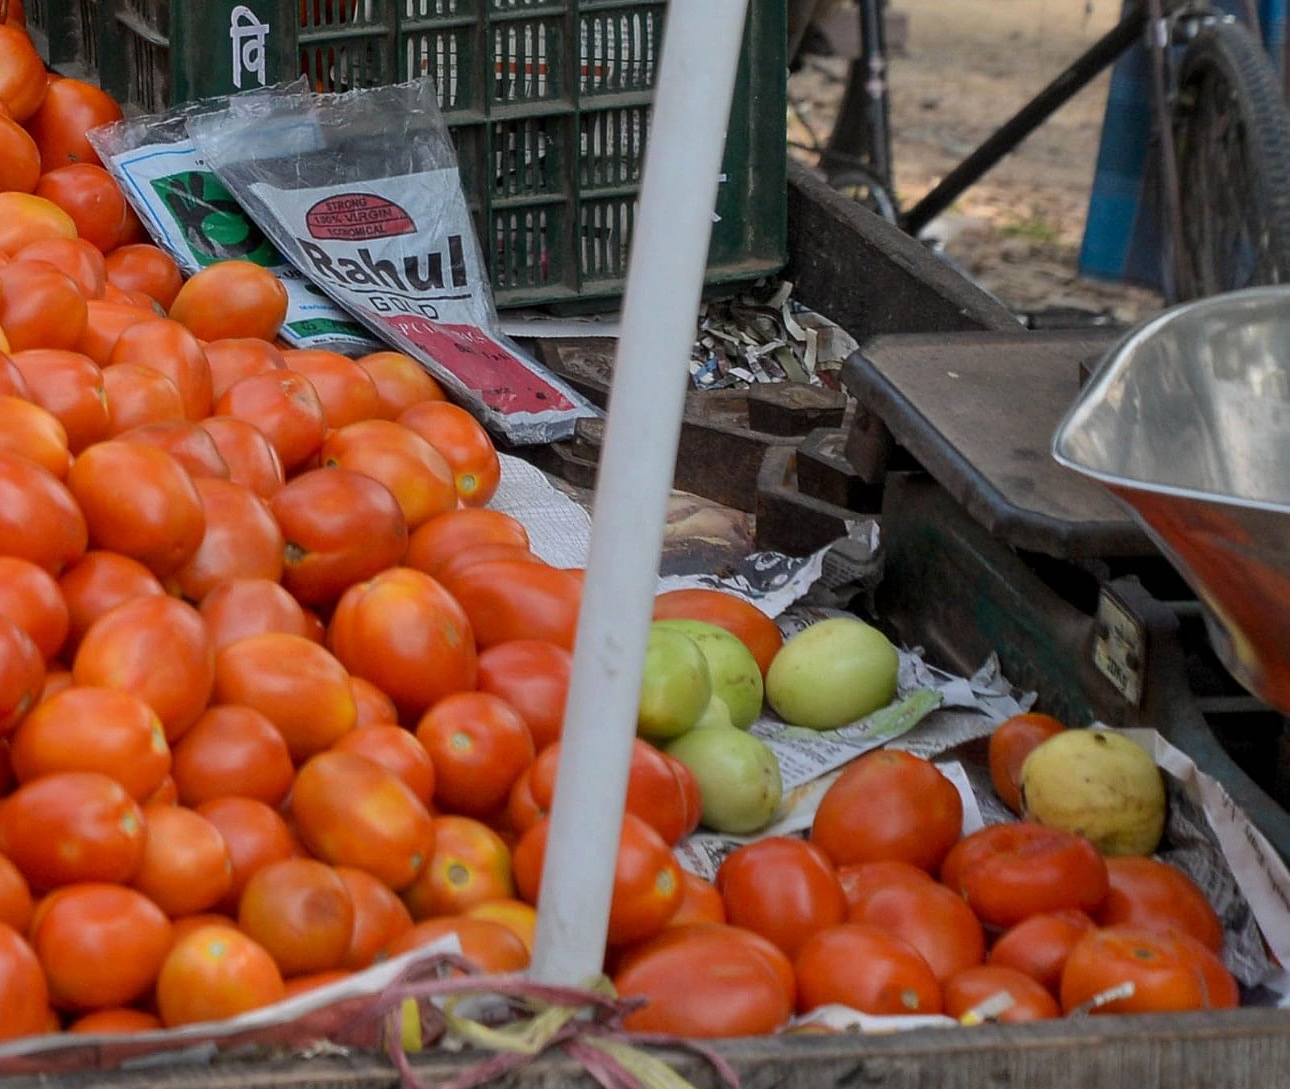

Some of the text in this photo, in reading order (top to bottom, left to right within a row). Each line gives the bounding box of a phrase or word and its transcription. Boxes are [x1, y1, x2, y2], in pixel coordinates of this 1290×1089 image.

[326, 198, 367, 211] STRONG
[346, 208, 393, 223] VIRGIN
[297, 235, 468, 291] Rahul
[369, 297, 439, 320] GOLD
